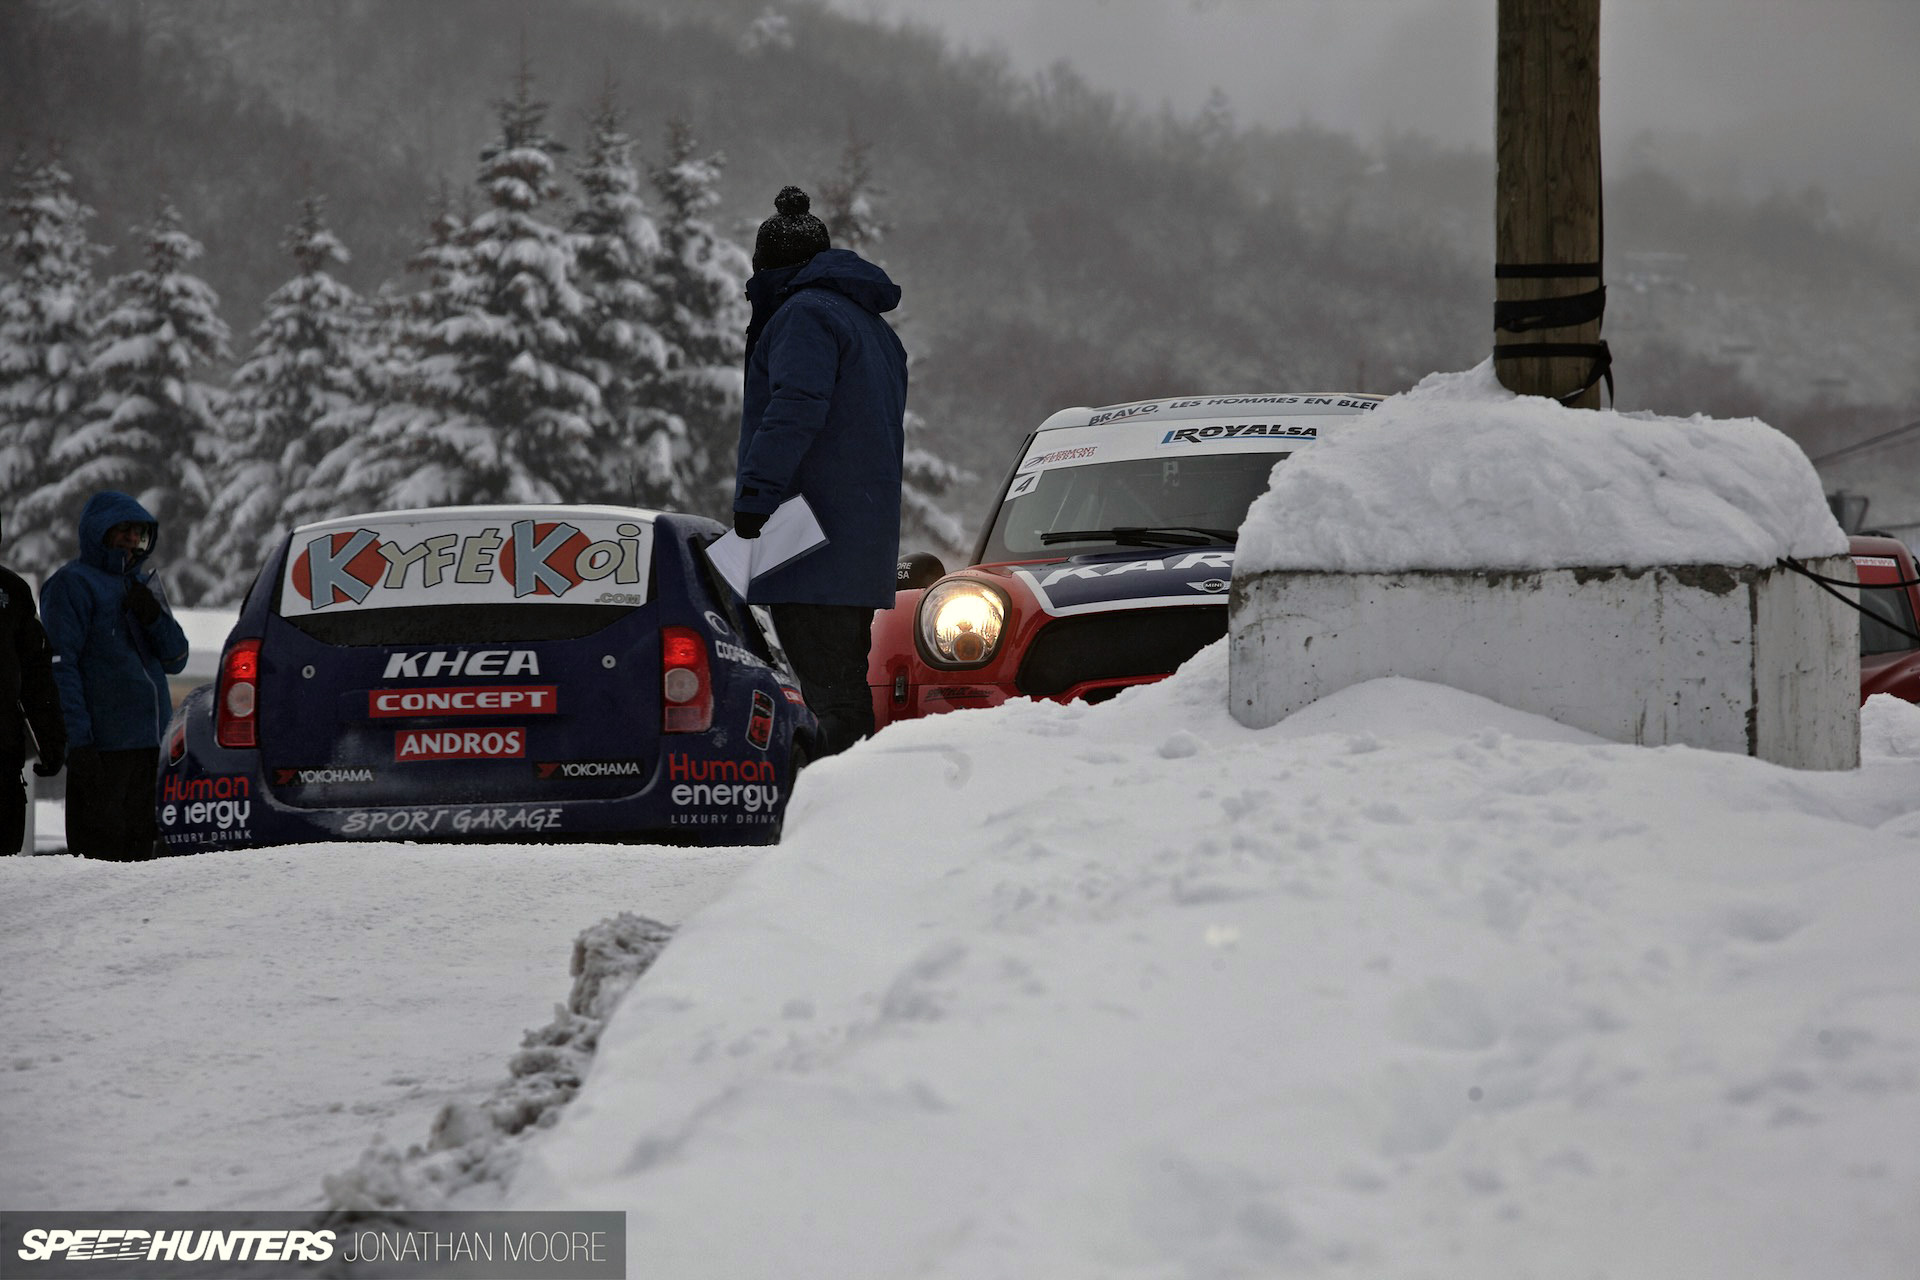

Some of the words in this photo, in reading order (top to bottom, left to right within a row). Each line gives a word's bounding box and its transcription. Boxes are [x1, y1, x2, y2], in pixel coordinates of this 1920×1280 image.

[1089, 404, 1159, 426] BRAVO,
[1170, 399, 1202, 409] LES
[1207, 396, 1298, 406] HOMMES
[1304, 397, 1331, 406] EN
[1014, 475, 1036, 493] 4
[383, 650, 540, 678] KHEA
[376, 691, 548, 711] CONCEPT
[400, 730, 520, 756] ANDROS
[298, 768, 373, 784] YOKOHAMA
[561, 762, 641, 777] YOKOHAMA
[668, 752, 776, 782] Human
[163, 774, 250, 802] Human
[671, 783, 779, 813] energy
[341, 808, 451, 834] SPORT
[452, 807, 564, 833] GARAGE
[671, 814, 728, 824] LUXURY
[736, 814, 778, 824] DRINK
[164, 834, 204, 844] LUXURY
[211, 830, 252, 841] DRINK
